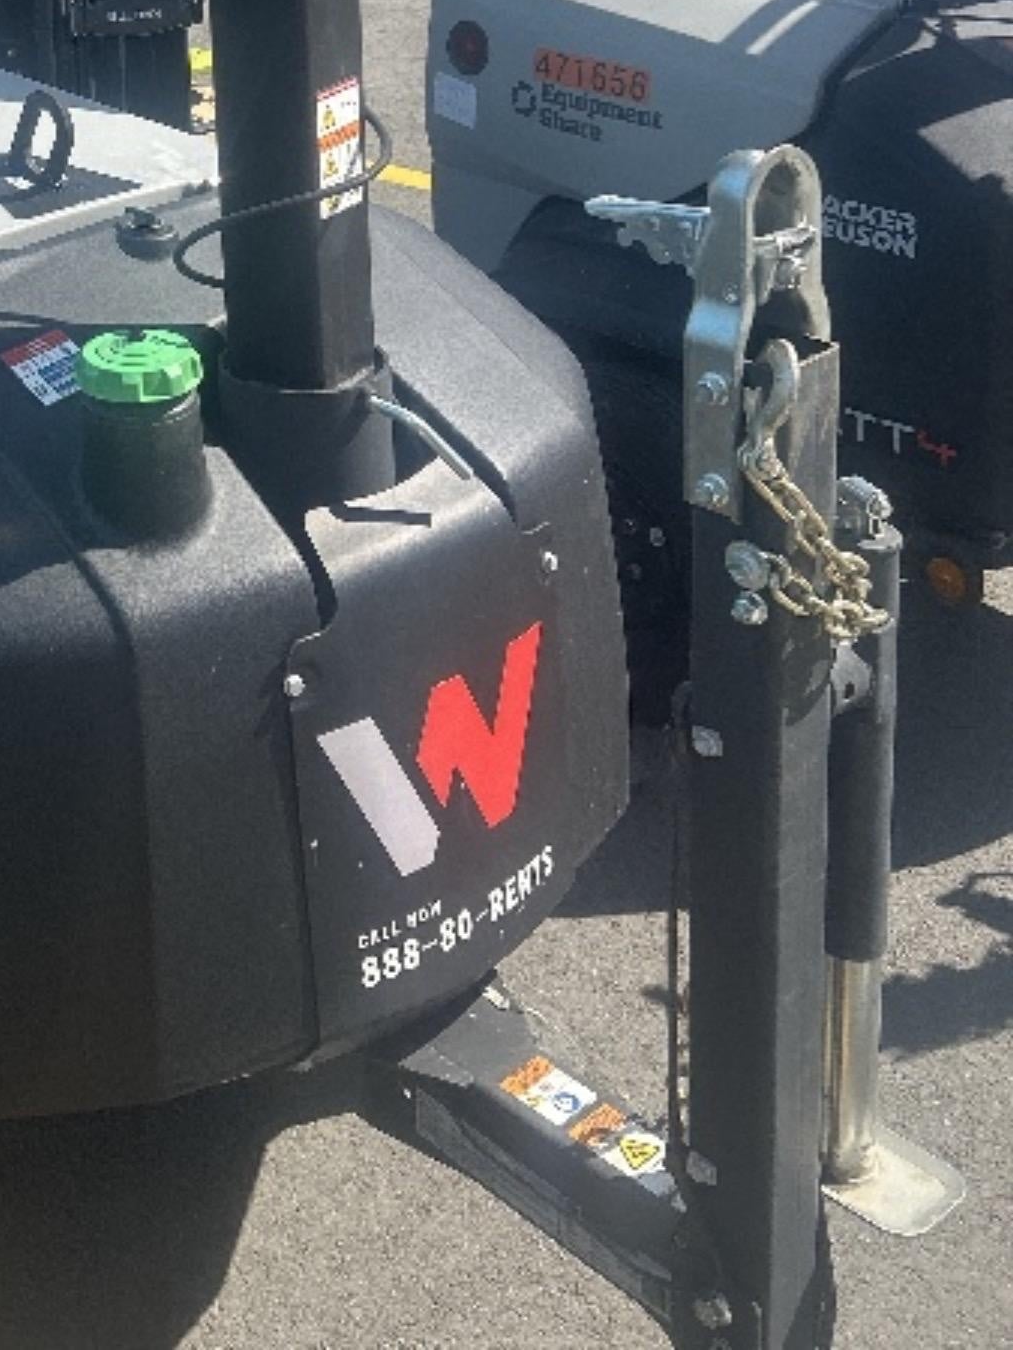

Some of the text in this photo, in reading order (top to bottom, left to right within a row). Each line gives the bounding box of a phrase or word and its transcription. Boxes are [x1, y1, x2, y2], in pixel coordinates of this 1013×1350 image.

[535, 52, 646, 101] 471656
[539, 108, 603, 142] Share
[541, 82, 664, 130] Equipment
[823, 216, 918, 259] EUSON
[824, 194, 916, 235] ACKER
[837, 407, 957, 466] TT4
[358, 899, 442, 949] CALL NOW
[361, 845, 553, 989] 888-80-RENTS
